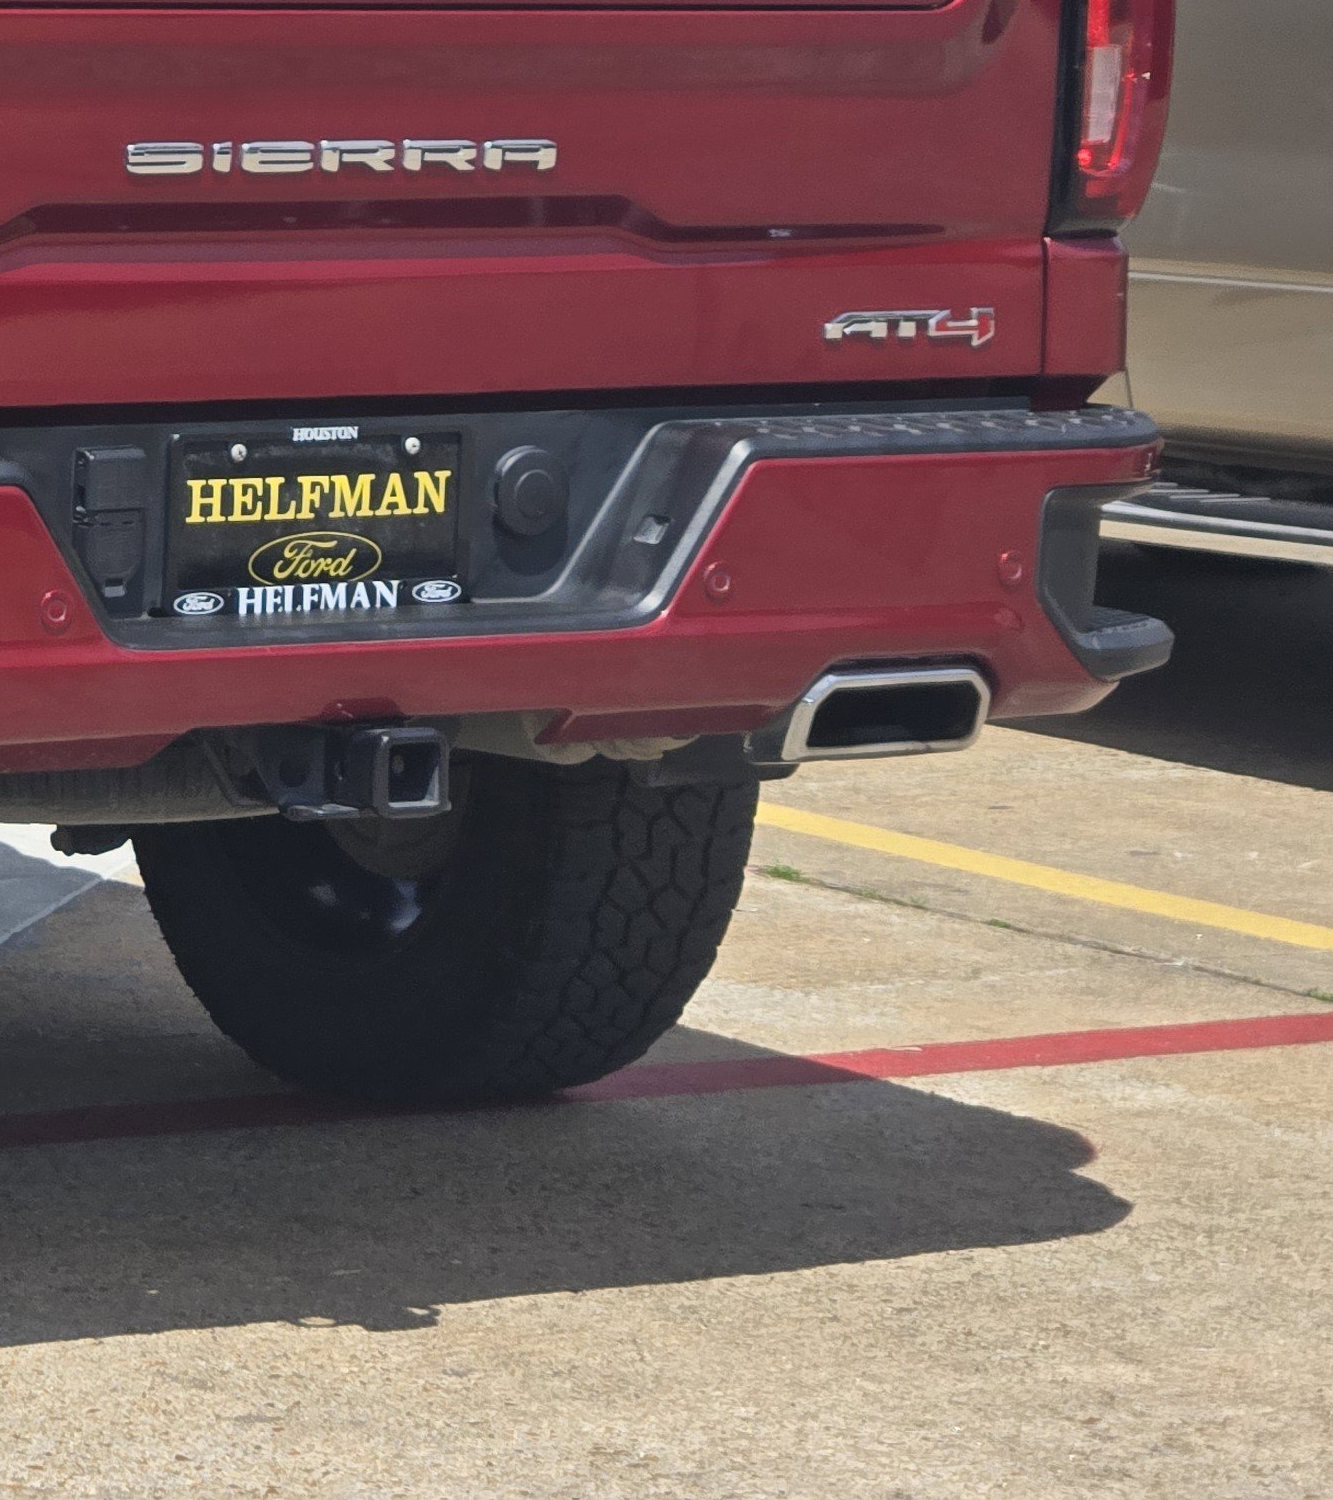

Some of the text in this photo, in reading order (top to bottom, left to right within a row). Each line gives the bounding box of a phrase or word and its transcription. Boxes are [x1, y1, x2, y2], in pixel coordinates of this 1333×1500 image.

[126, 138, 558, 175] SIERRA
[823, 306, 996, 347] AT4
[292, 425, 359, 442] HOUSTON
[185, 470, 452, 524] HELFMAN
[273, 539, 358, 580] Ford
[237, 579, 400, 616] HELFMAN
